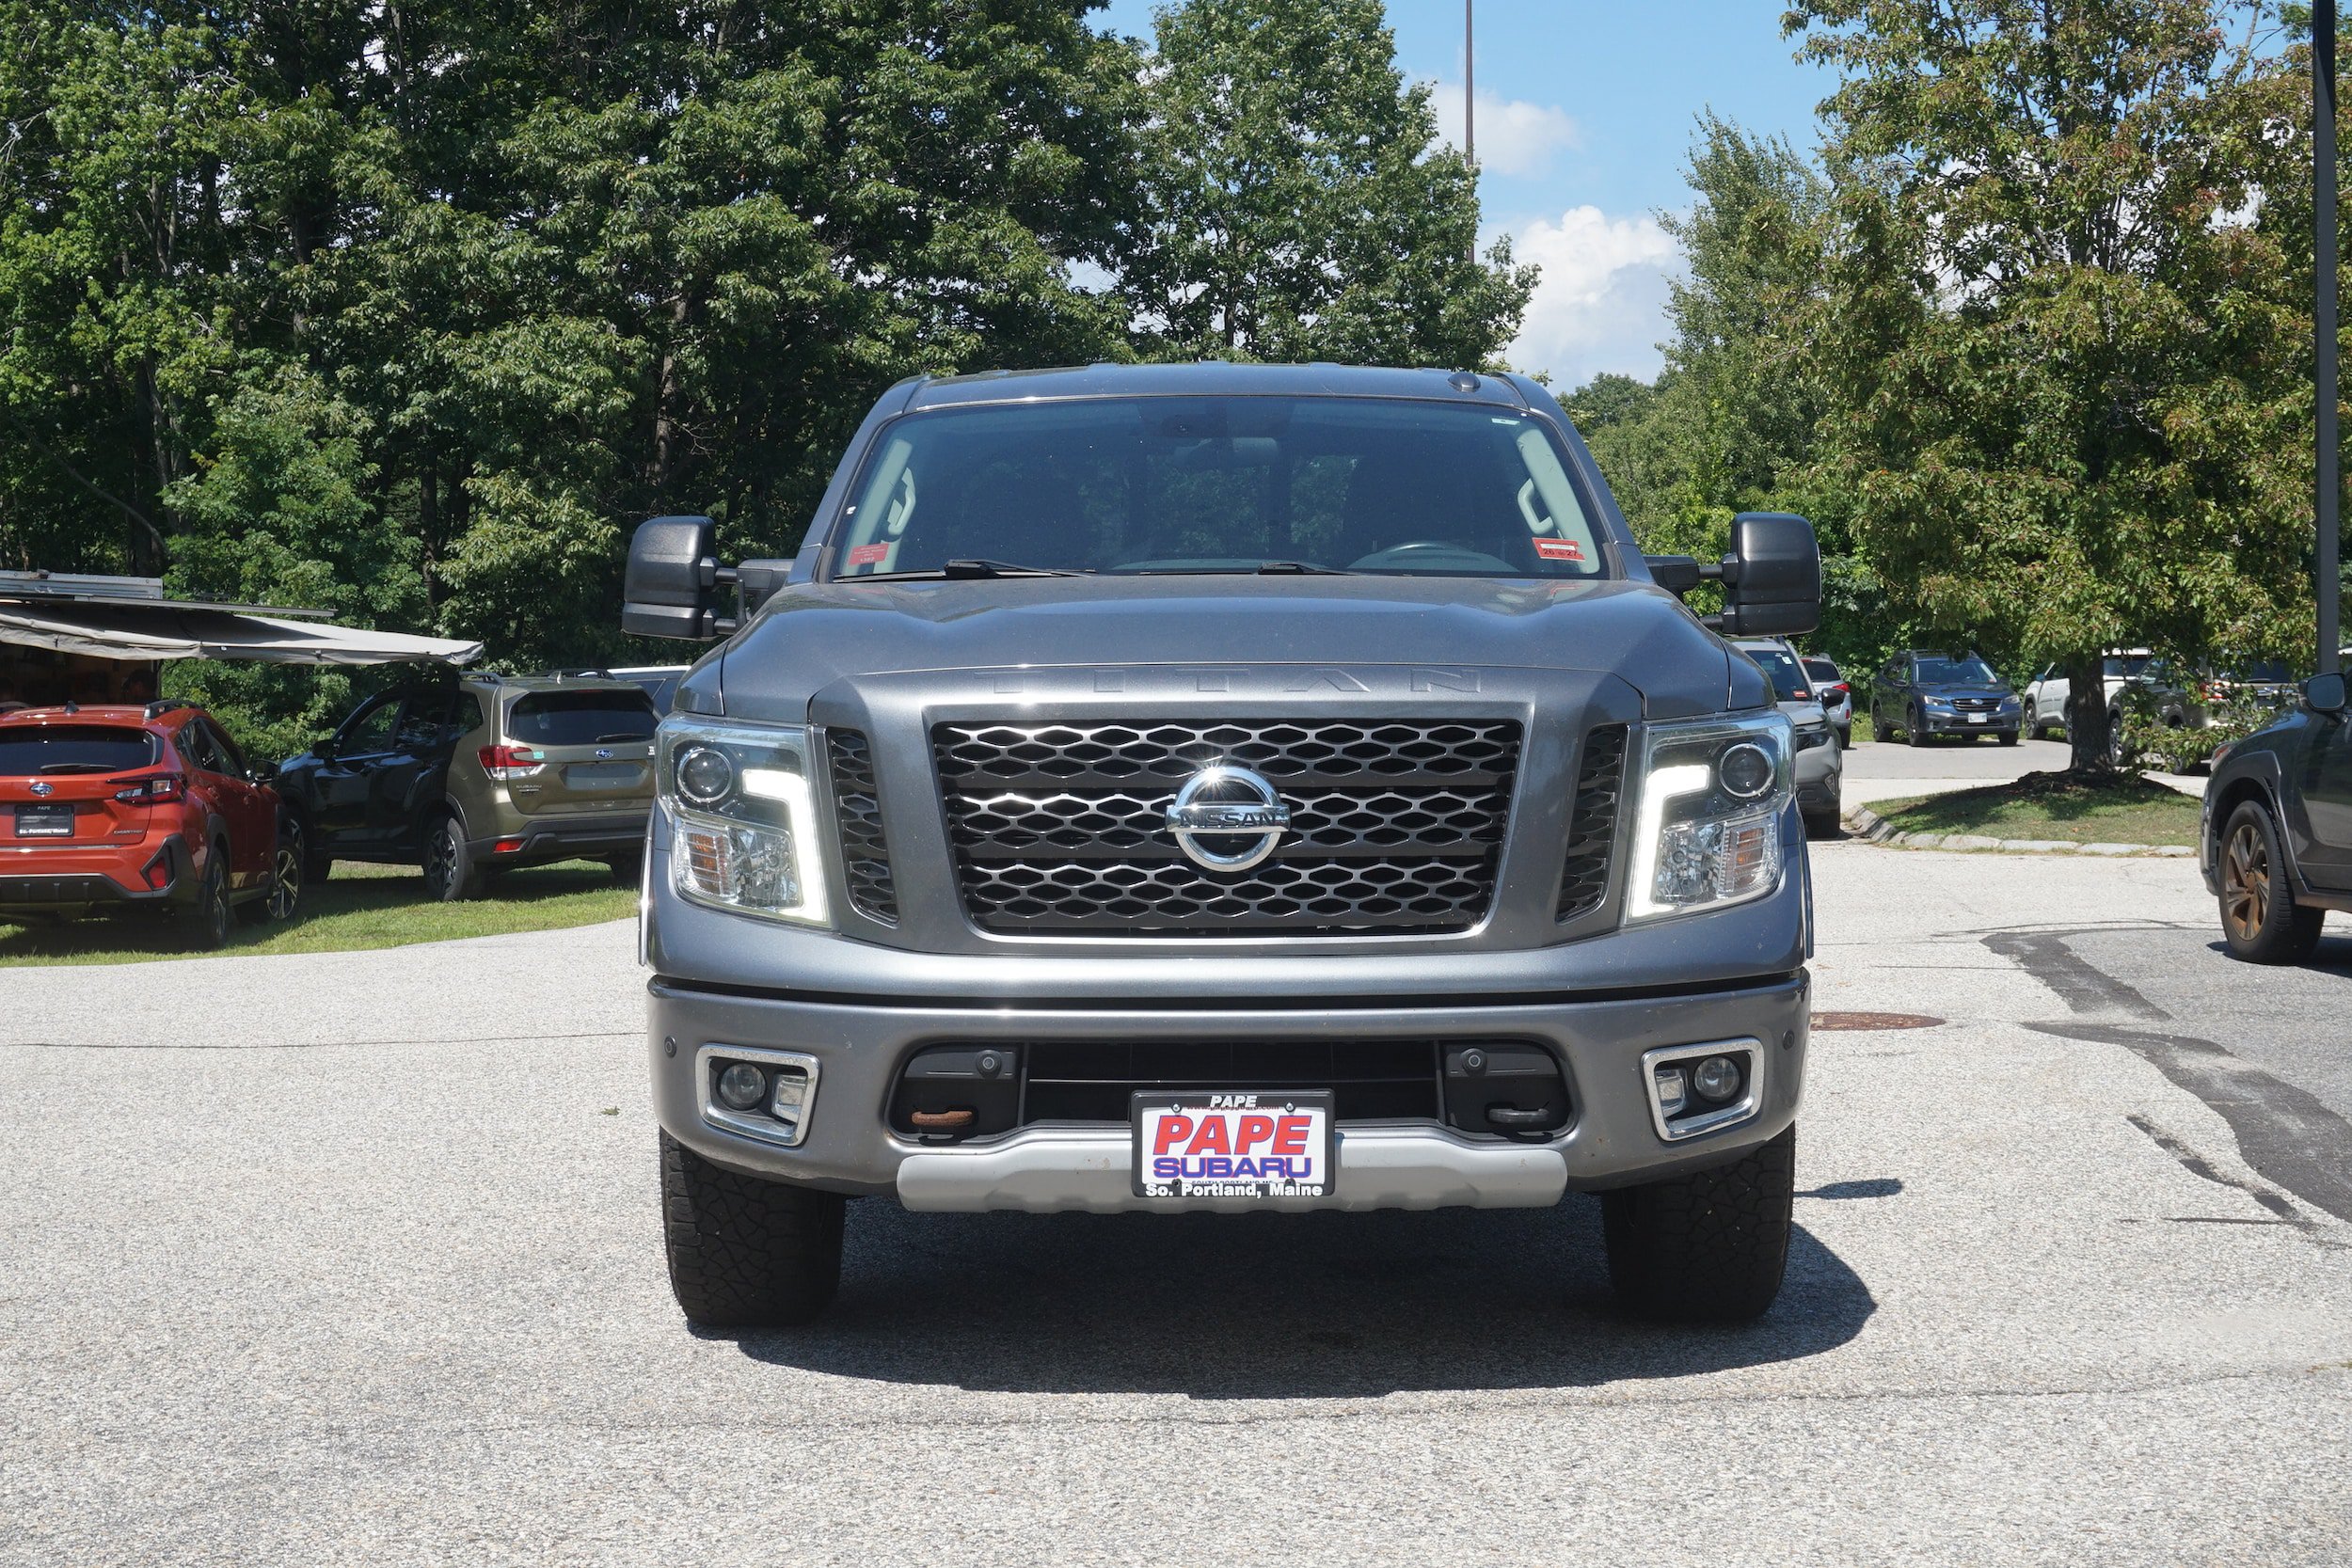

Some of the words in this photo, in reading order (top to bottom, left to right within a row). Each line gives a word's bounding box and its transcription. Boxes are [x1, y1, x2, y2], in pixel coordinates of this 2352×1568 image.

[975, 667, 1482, 694] TITAN
[1210, 1095, 1257, 1107] PAPE
[1152, 1115, 1312, 1155] PAPE
[1153, 1157, 1311, 1179] SUBARU
[1145, 1182, 1173, 1196] So.
[1181, 1182, 1262, 1199] Portland,
[1269, 1182, 1324, 1196] Maine
